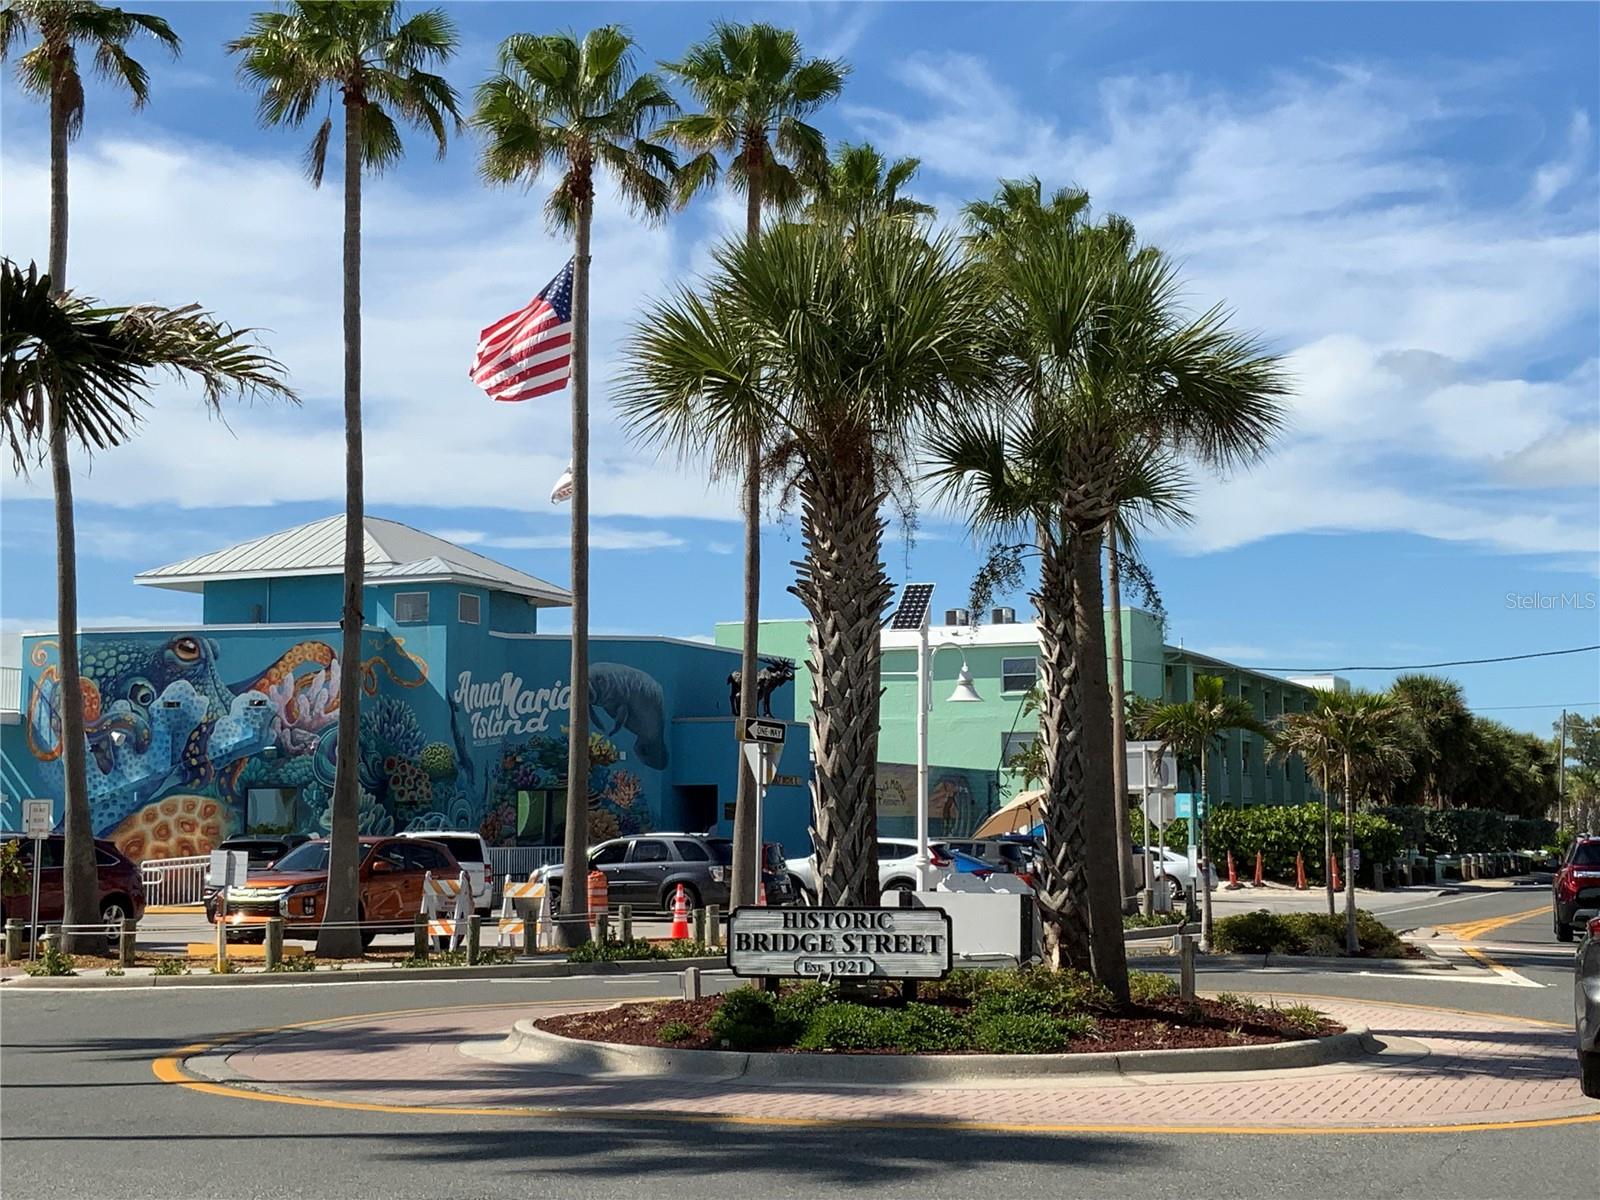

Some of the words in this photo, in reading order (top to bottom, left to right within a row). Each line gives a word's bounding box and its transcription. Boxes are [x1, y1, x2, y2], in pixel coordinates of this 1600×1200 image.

[454, 671, 501, 713] Anna
[471, 708, 549, 739] Island
[757, 726, 769, 736] ONE
[770, 728, 782, 738] WAY
[783, 912, 893, 930] HISTORIC
[735, 932, 834, 953] BRIDGE
[842, 934, 944, 954] STREET
[829, 961, 867, 974] 1921
